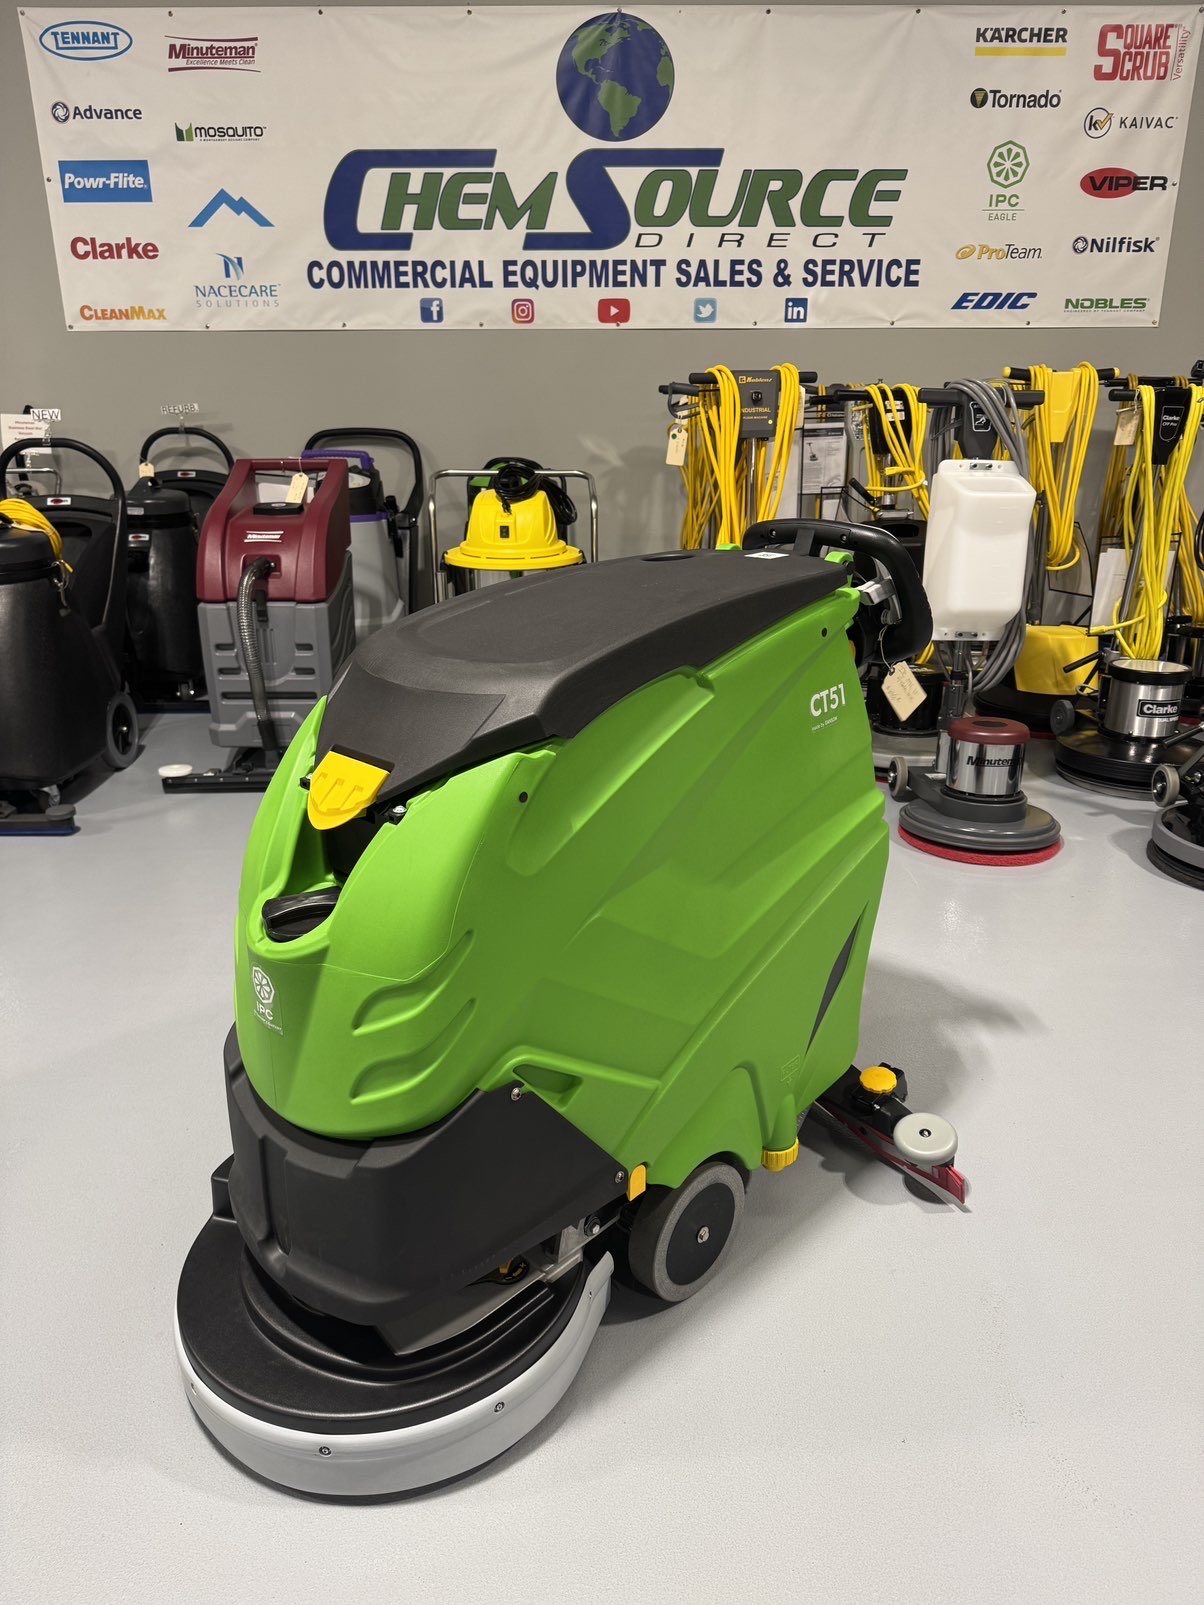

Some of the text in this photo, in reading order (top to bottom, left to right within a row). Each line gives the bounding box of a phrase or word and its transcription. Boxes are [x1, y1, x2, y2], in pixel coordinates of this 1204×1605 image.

[51, 31, 120, 49] TENNANT
[976, 27, 1068, 43] KÄRCHER
[168, 43, 255, 59] Minuteman
[1173, 28, 1191, 80] Versatility
[989, 89, 1061, 109] Tornado
[72, 105, 143, 120] Advance
[1119, 116, 1175, 129] KAIVAC
[194, 126, 264, 138] MOSQUITO
[64, 172, 145, 190] Powr-Flite
[1089, 175, 1168, 191] VIPER
[988, 194, 1020, 208] IPC
[988, 212, 1017, 221] EAGLE
[70, 236, 159, 260] Clarke
[635, 232, 887, 249] DIRECT
[1090, 237, 1156, 253] Nilfisk
[977, 244, 1041, 260] ProTeam
[306, 258, 921, 291] COMMERCIAL EQUIPMENT SALES & SERVICE
[194, 284, 278, 298] NACECARE
[196, 299, 279, 308] SOLUTIONS
[951, 292, 1037, 310] EDIC
[1064, 298, 1147, 309] NOBLES
[32, 409, 60, 420] NEW
[810, 683, 846, 717] CT51
[1143, 704, 1178, 714] Clarke
[256, 1001, 274, 1020] IPC
